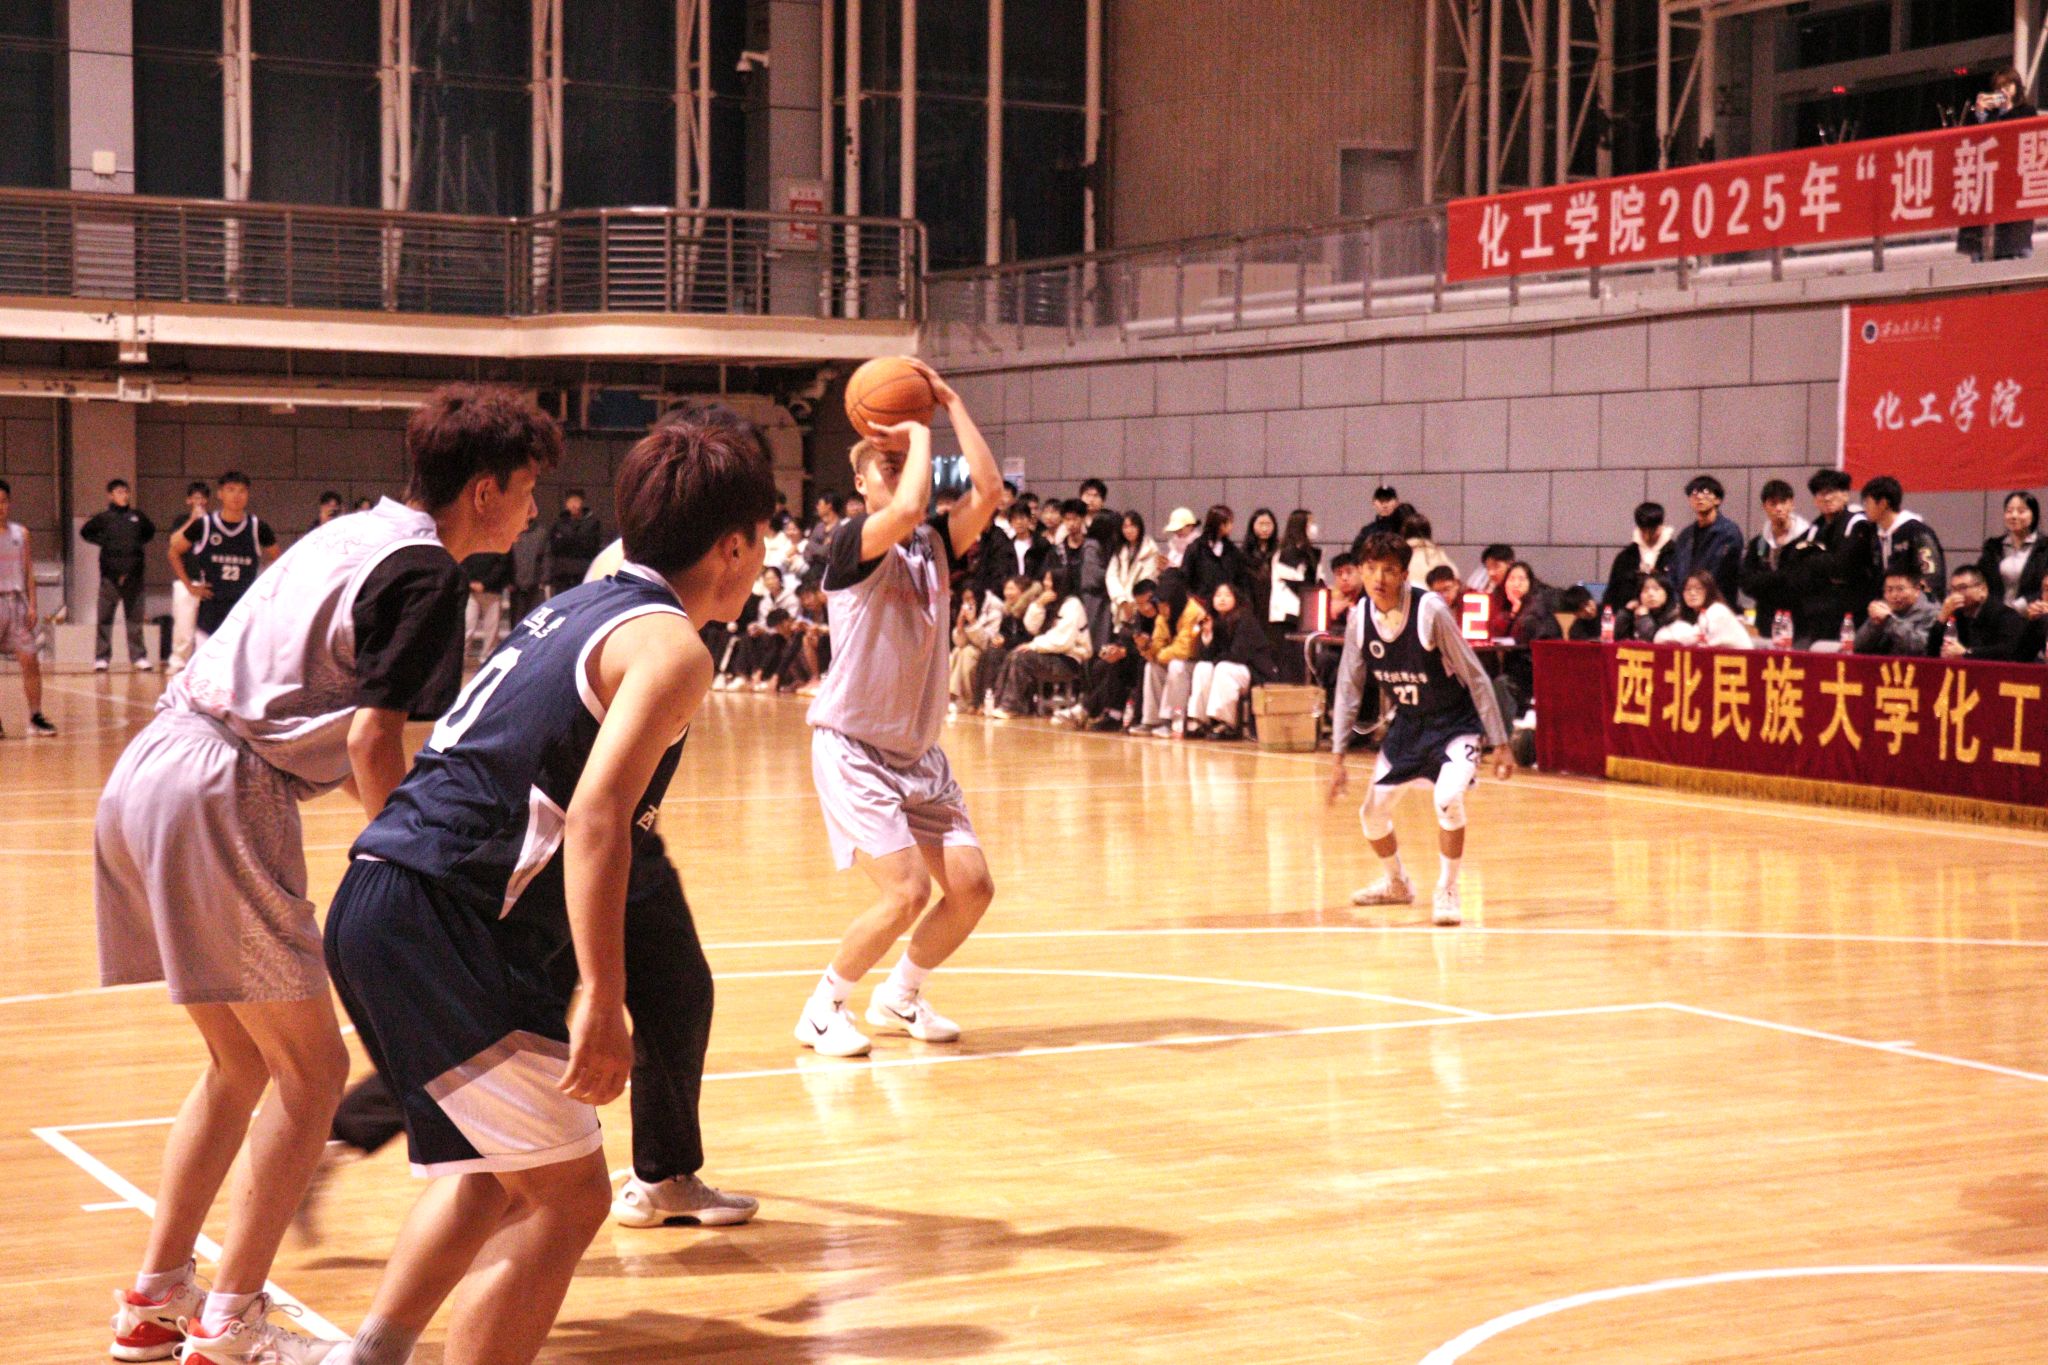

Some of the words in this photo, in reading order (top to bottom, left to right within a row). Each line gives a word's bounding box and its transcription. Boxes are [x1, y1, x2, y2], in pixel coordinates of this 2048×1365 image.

[1873, 375, 2025, 432] 化工学院
[1462, 593, 1490, 640] 2
[1612, 646, 2042, 768] 西北民族大学化工
